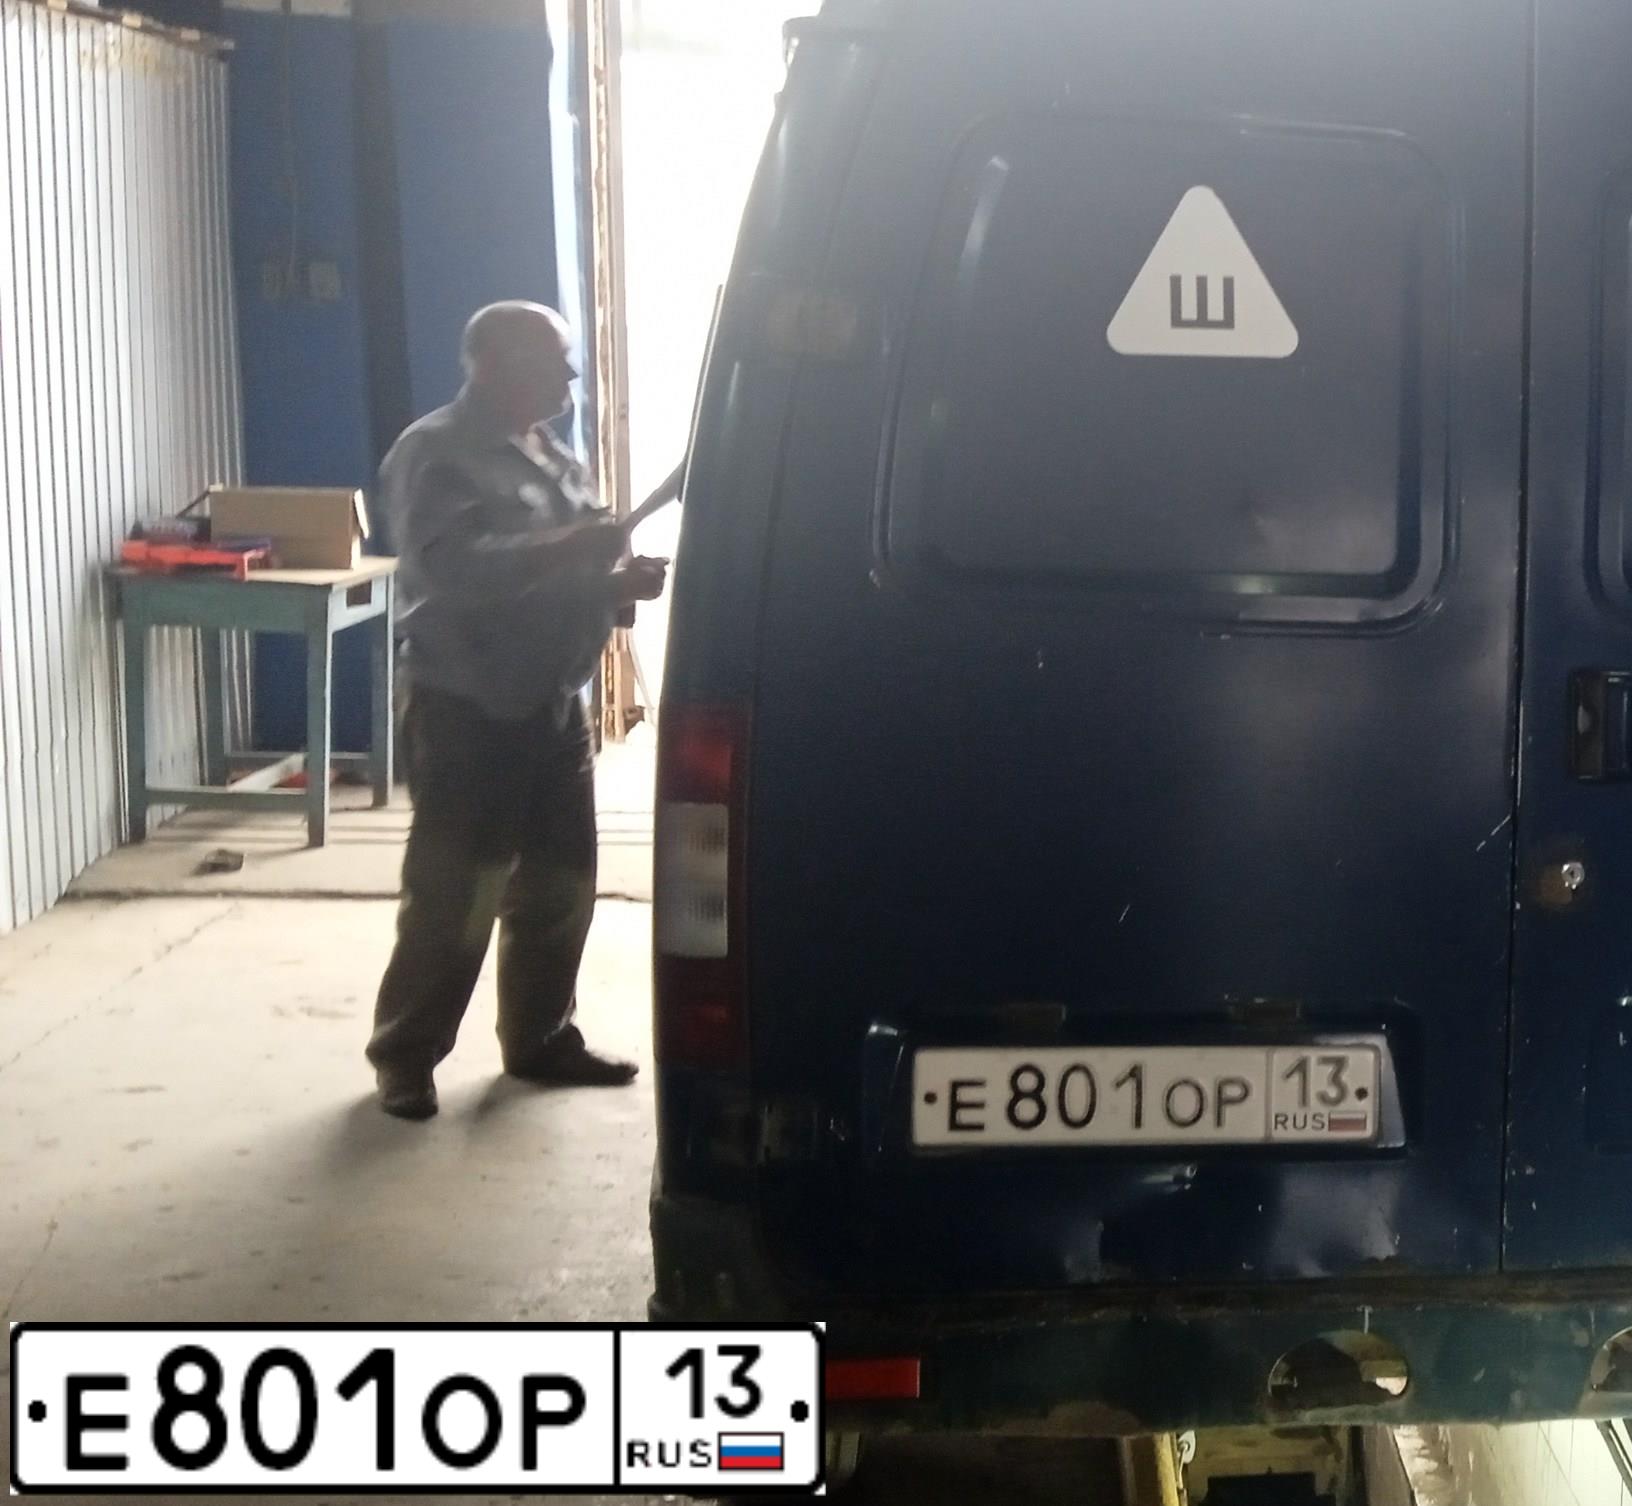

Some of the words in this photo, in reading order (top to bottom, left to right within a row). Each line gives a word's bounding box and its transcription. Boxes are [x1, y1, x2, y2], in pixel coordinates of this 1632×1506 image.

[1169, 273, 1235, 330] Ш
[1280, 1055, 1350, 1106] 13
[1273, 1113, 1326, 1131] RUS
